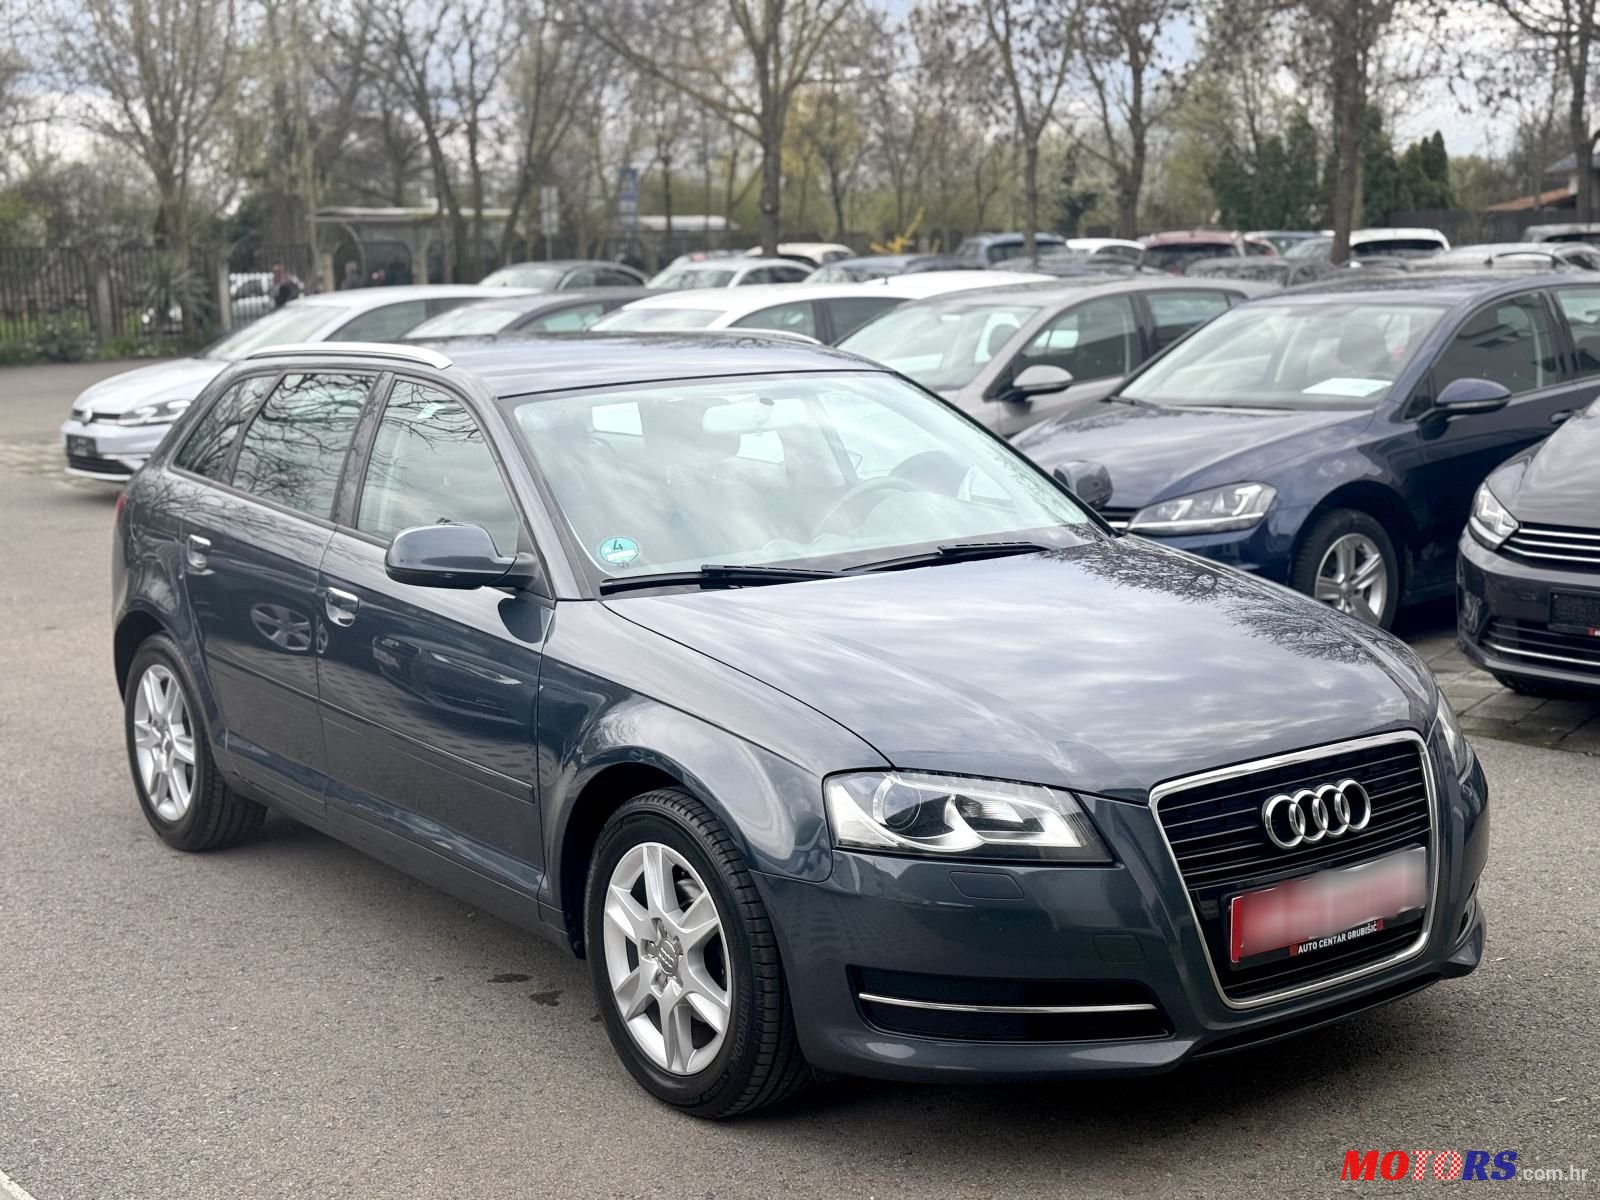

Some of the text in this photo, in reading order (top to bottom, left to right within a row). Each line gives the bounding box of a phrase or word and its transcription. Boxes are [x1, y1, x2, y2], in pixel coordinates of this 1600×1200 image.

[612, 539, 624, 551] 4
[1297, 941, 1318, 954] AUTO
[1318, 932, 1347, 948] CENTAR
